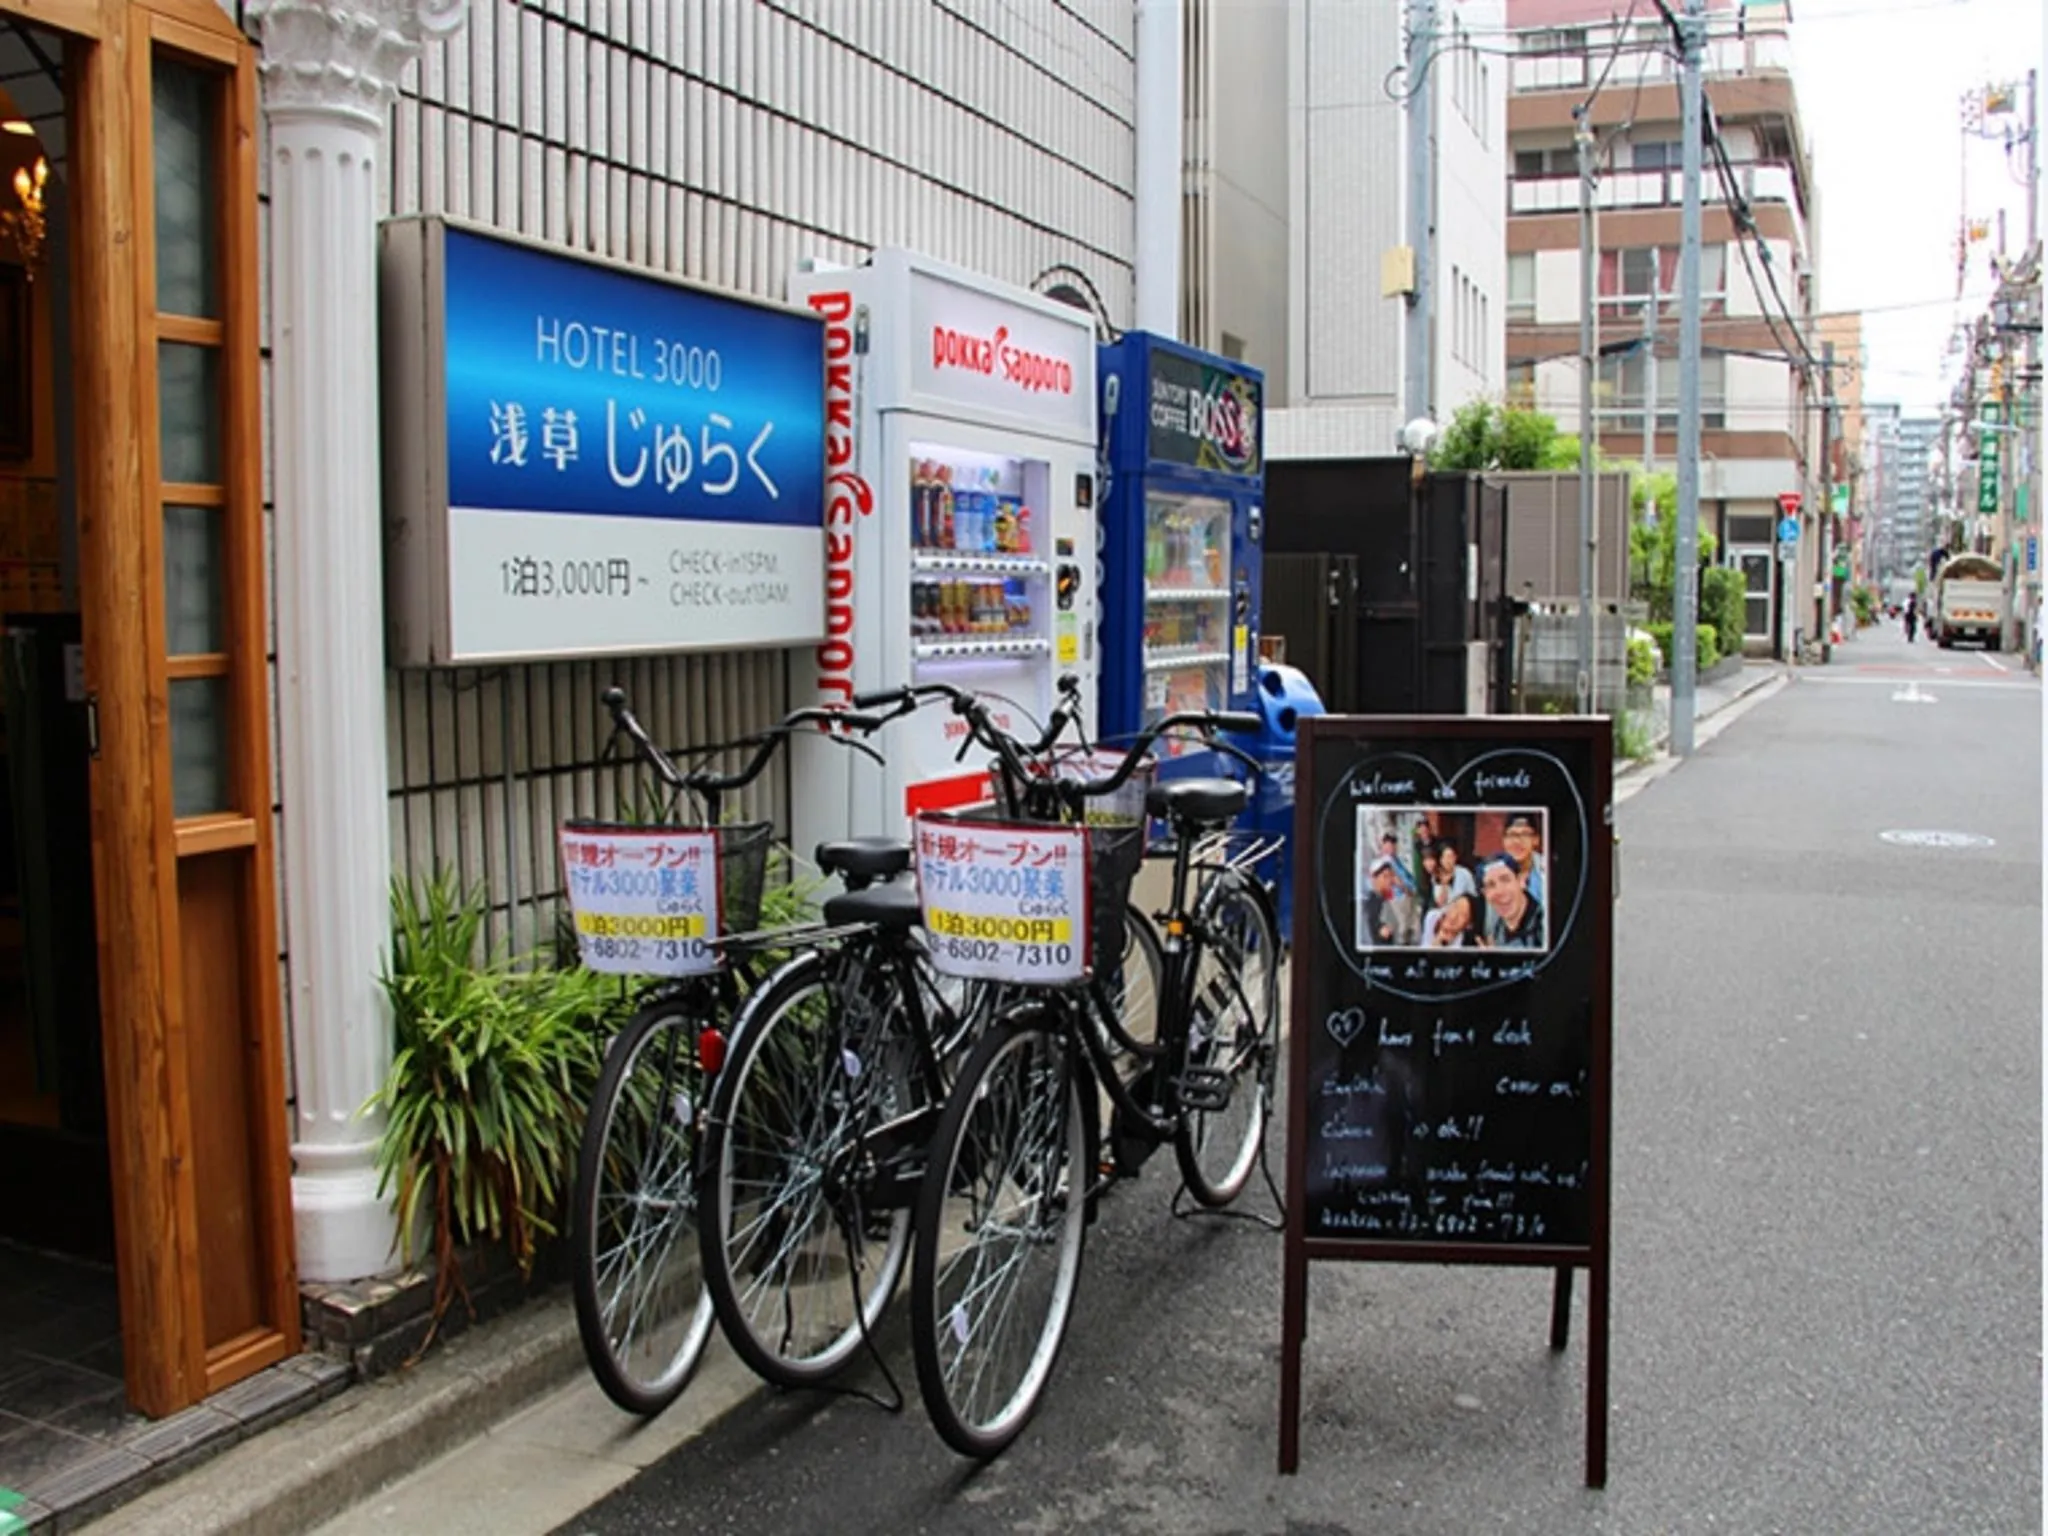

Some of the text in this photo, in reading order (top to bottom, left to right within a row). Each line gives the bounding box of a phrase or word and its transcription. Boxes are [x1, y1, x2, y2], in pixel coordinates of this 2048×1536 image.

[537, 315, 721, 392] HOTEL 3000
[489, 398, 779, 500] 浅草 じゅらく
[936, 912, 1055, 941] 1泊3000円
